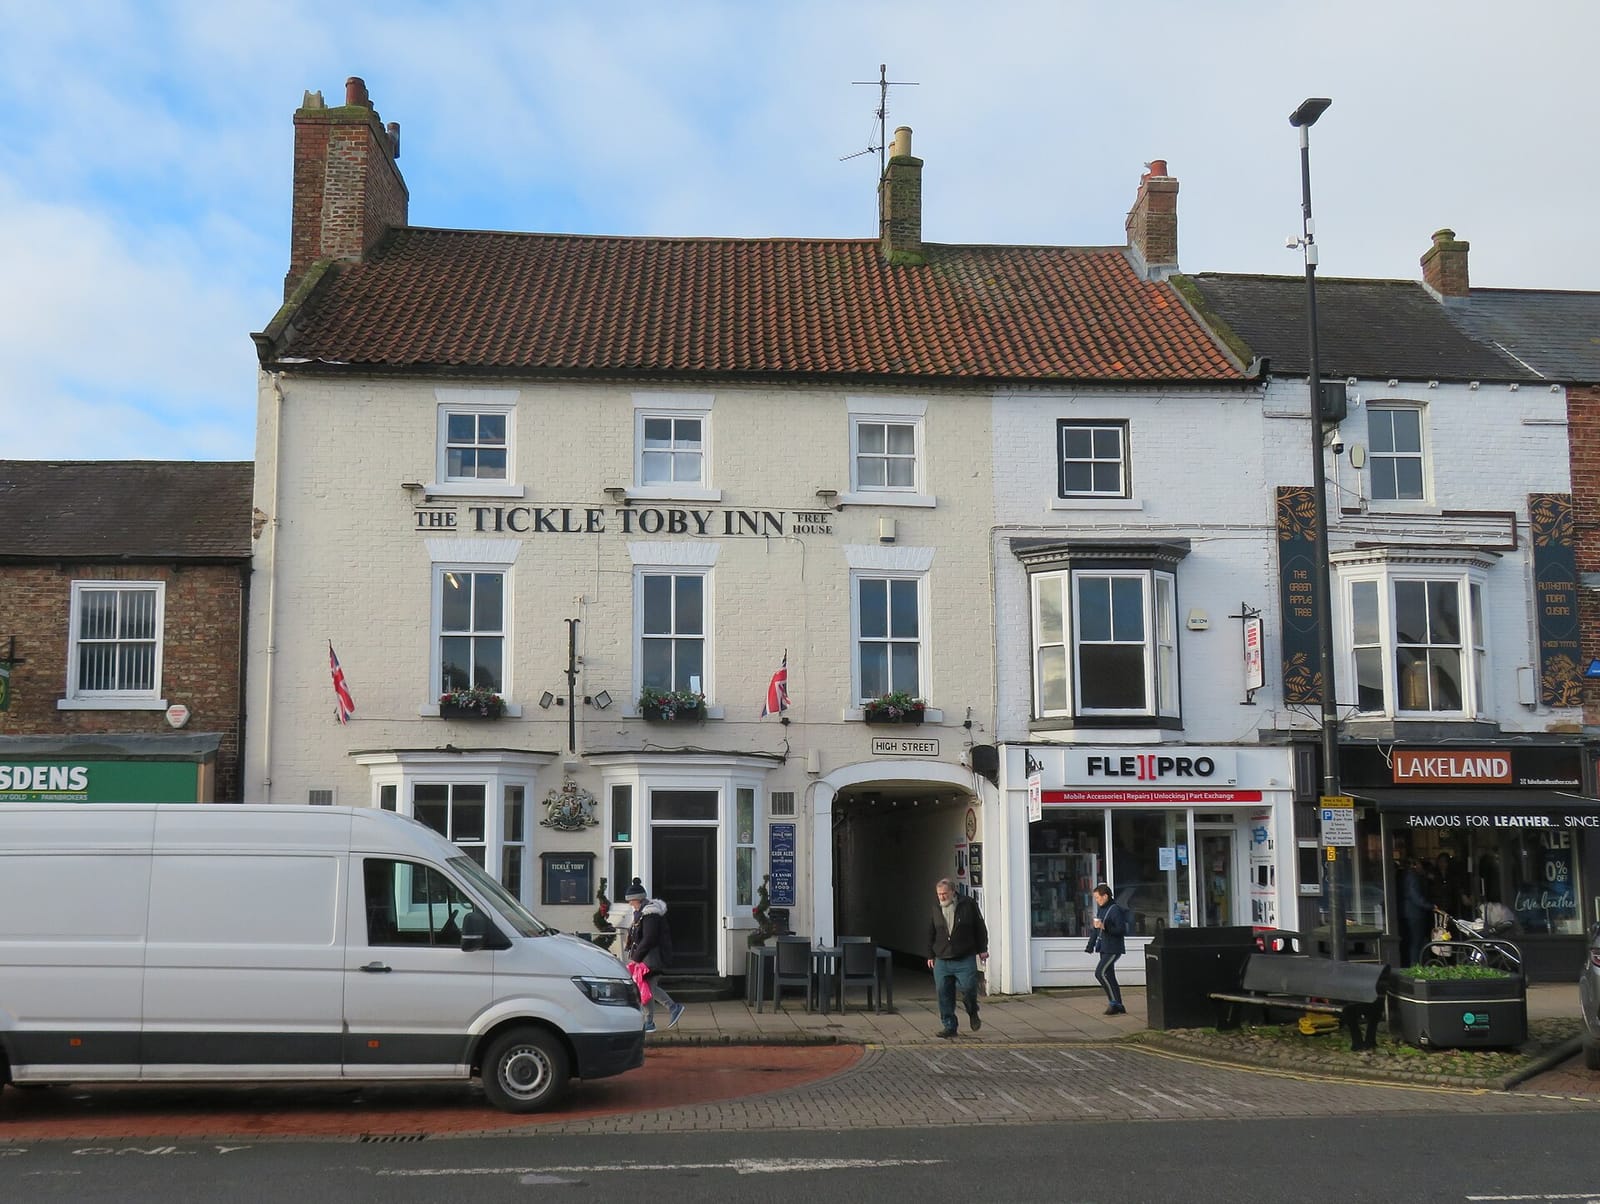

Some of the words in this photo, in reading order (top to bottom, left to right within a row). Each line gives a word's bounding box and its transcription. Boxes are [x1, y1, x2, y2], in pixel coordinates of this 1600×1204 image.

[416, 511, 457, 527] THE
[468, 506, 606, 533] TICKLE
[615, 508, 711, 535] TOBY
[723, 510, 785, 535] INN
[797, 513, 828, 523] FREE
[792, 524, 833, 534] HOUSE
[876, 741, 897, 751] HIGH
[902, 742, 935, 752] STREET
[1397, 758, 1508, 778] LAKELAND
[0, 766, 88, 790] SDENS
[1204, 793, 1235, 801] Exchange
[1466, 815, 1490, 827] FOR
[1564, 815, 1600, 827] SINCE
[1328, 851, 1334, 860] 5
